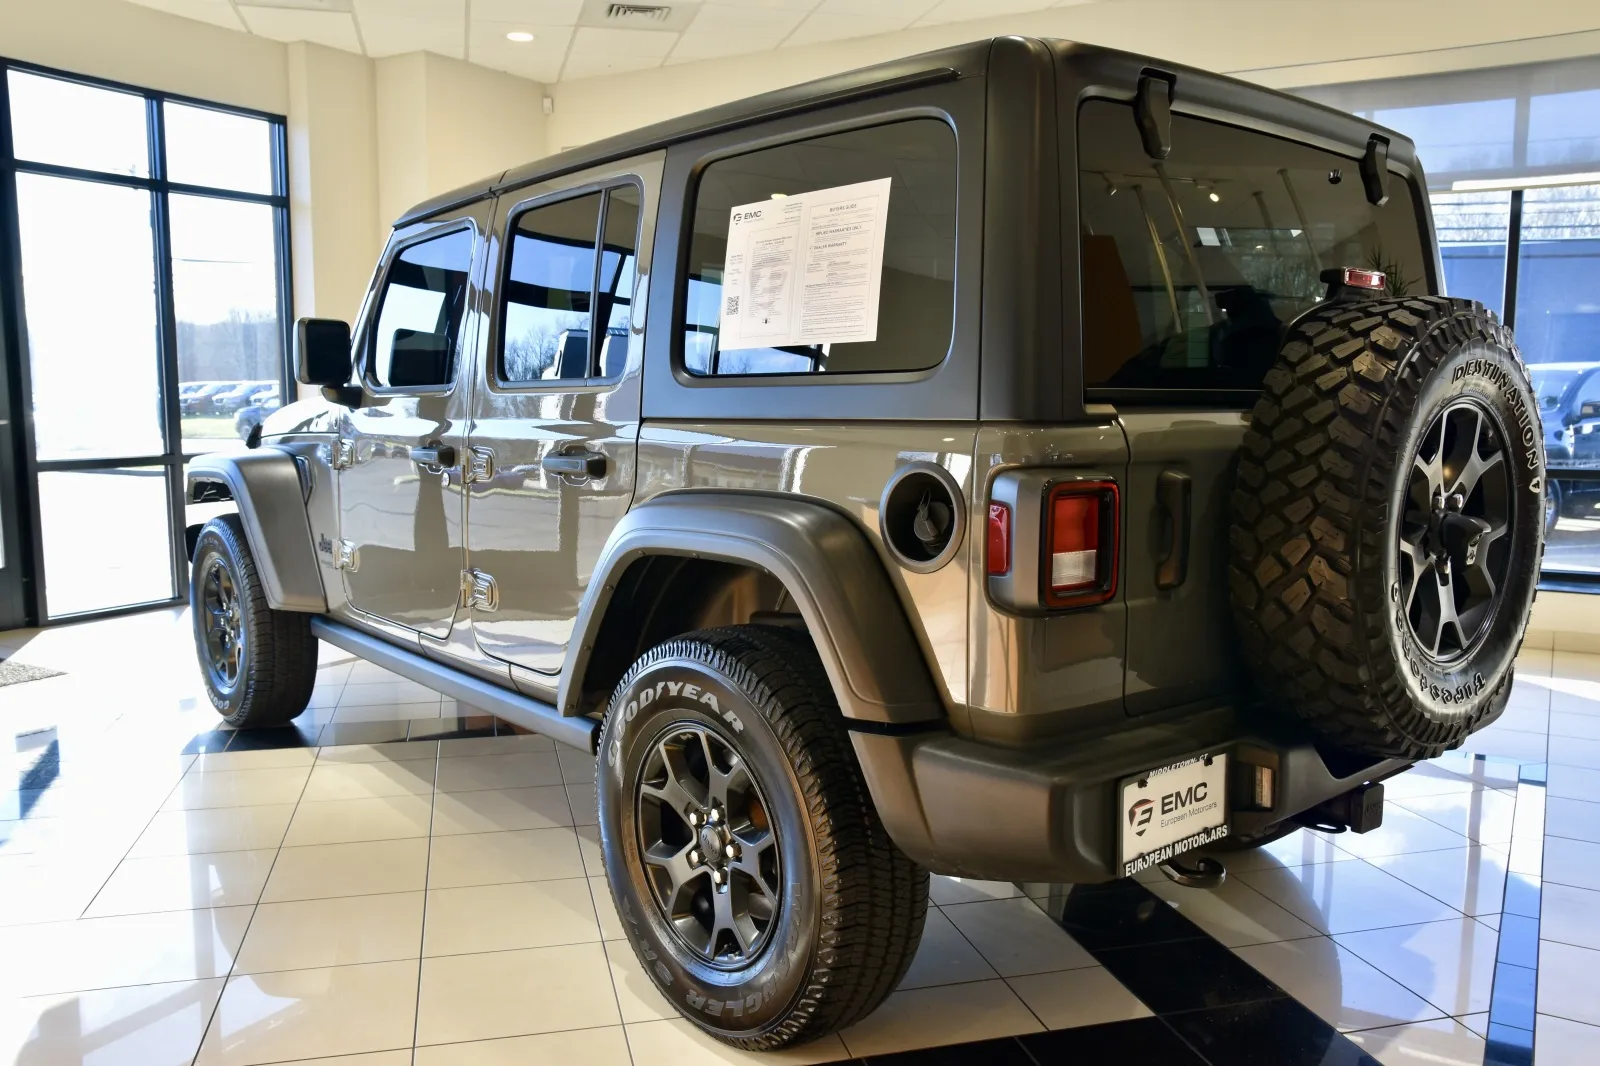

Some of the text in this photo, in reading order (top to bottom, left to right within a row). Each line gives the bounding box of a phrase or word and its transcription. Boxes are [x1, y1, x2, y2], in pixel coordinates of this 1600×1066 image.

[744, 210, 762, 220] EMC
[1452, 359, 1539, 470] DESTINATION
[608, 681, 744, 767] GOODYEAR
[1161, 782, 1208, 815] EMC
[1161, 801, 1218, 828] European Motorcars
[1125, 824, 1228, 877] EUROPEAN MOTORCARS
